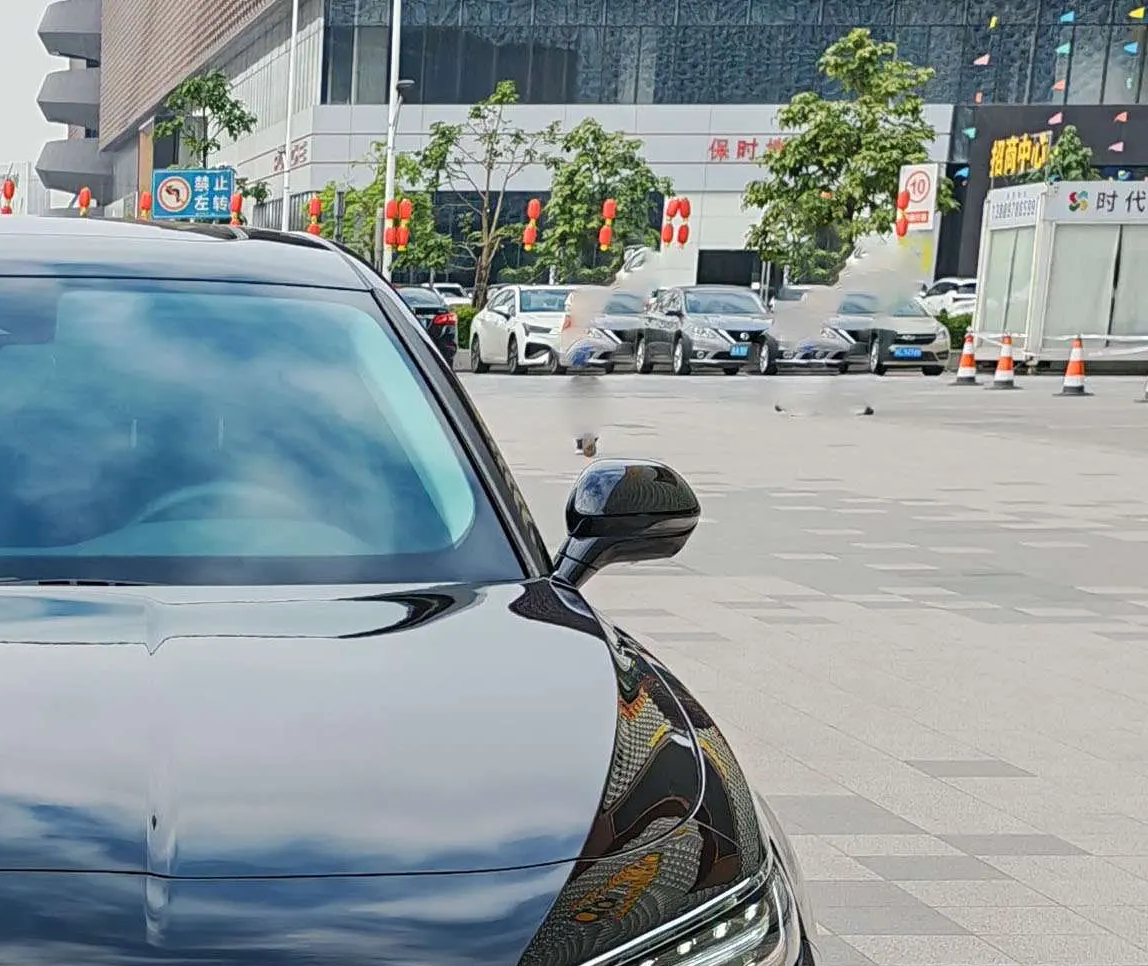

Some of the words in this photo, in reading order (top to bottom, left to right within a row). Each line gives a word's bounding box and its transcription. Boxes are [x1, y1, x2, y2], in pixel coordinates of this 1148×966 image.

[989, 132, 1050, 177] 招商中心
[194, 175, 228, 192] 禁止
[910, 179, 926, 195] 10
[194, 195, 228, 211] 左转
[1096, 190, 1147, 213] 时代
